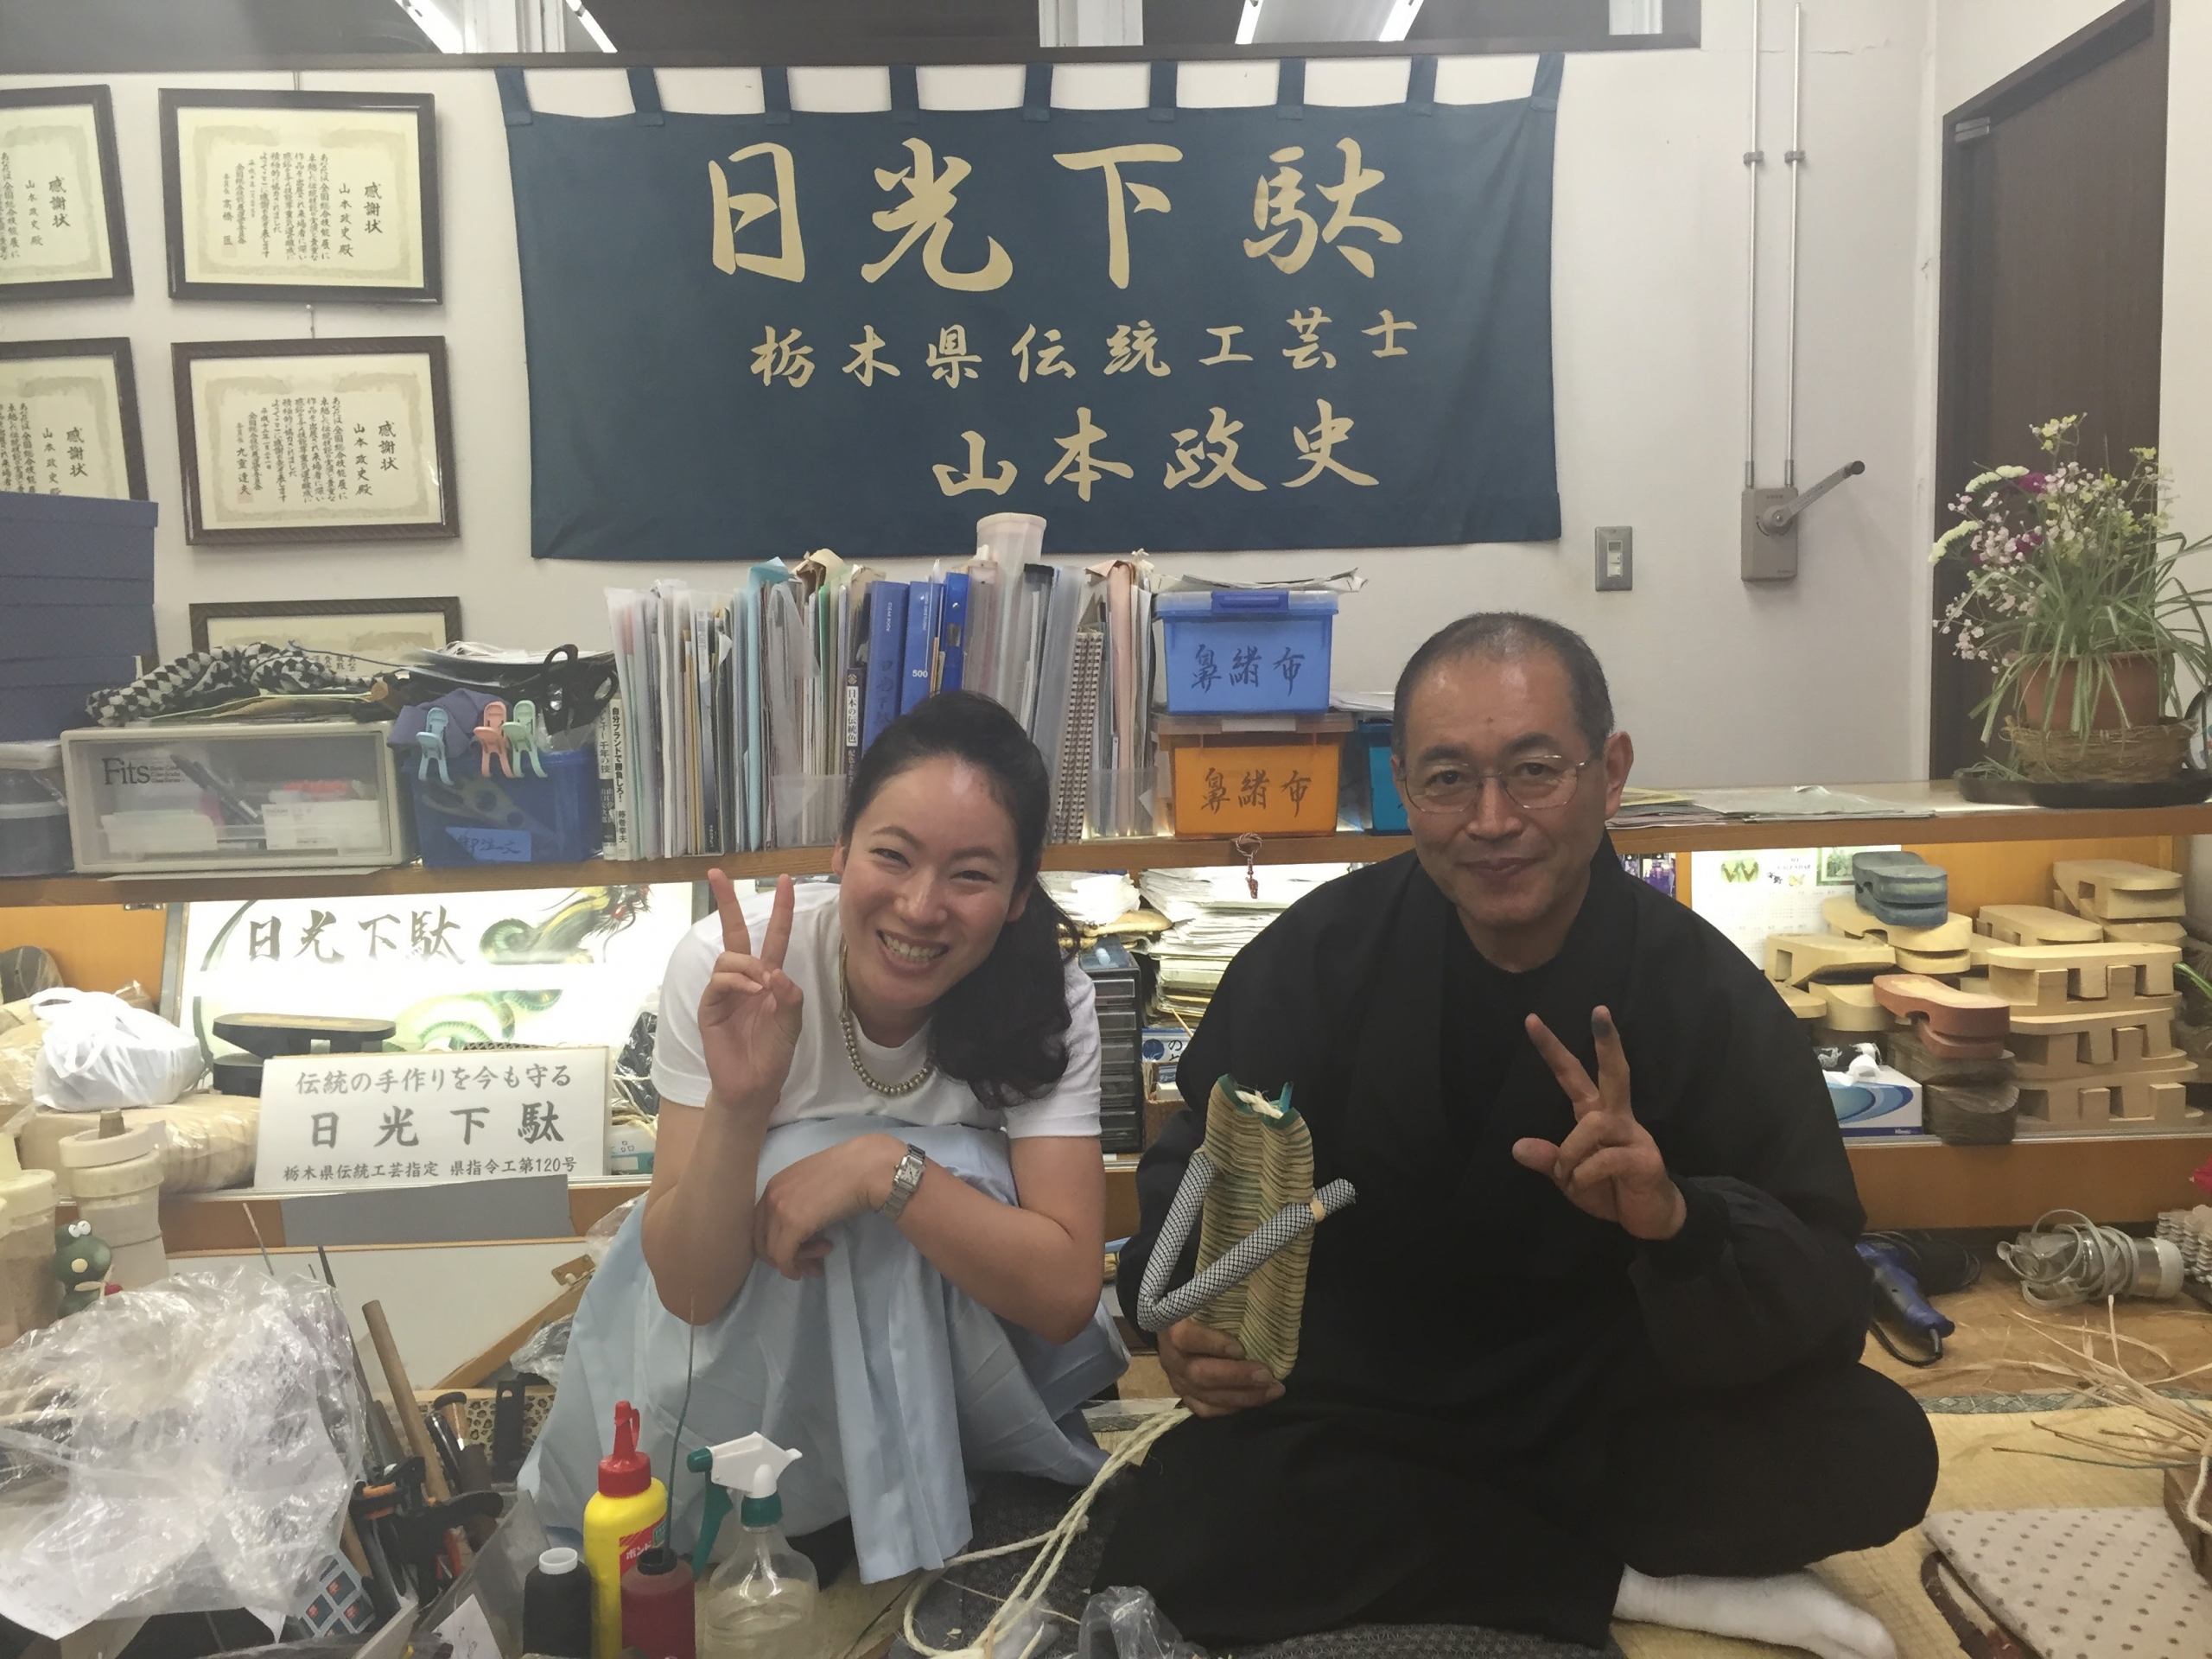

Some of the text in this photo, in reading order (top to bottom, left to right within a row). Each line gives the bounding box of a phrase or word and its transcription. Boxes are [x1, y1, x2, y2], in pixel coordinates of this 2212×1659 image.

[25, 180, 43, 245] 山本政史殿
[49, 175, 70, 227] 感謝状
[338, 183, 353, 257] 山本政史殿
[364, 181, 383, 233] 感謝状
[709, 138, 1401, 291] 日光下駄
[751, 308, 1414, 387] 栃木県伝統工芸士
[67, 427, 88, 477] 感謝状
[353, 423, 372, 496] 山本政史殿
[378, 421, 398, 471] 感謝状
[933, 399, 1376, 500] 山本政史
[848, 690, 856, 743] 日本の伝統色
[102, 757, 150, 785] Fits
[248, 904, 466, 965] 日光下駄
[296, 1064, 571, 1095] 伝統の手作りを今も守る
[311, 1100, 564, 1148] 日光下駄
[283, 1156, 577, 1182] 栃木県伝統工芸指定 県指令工第120号
